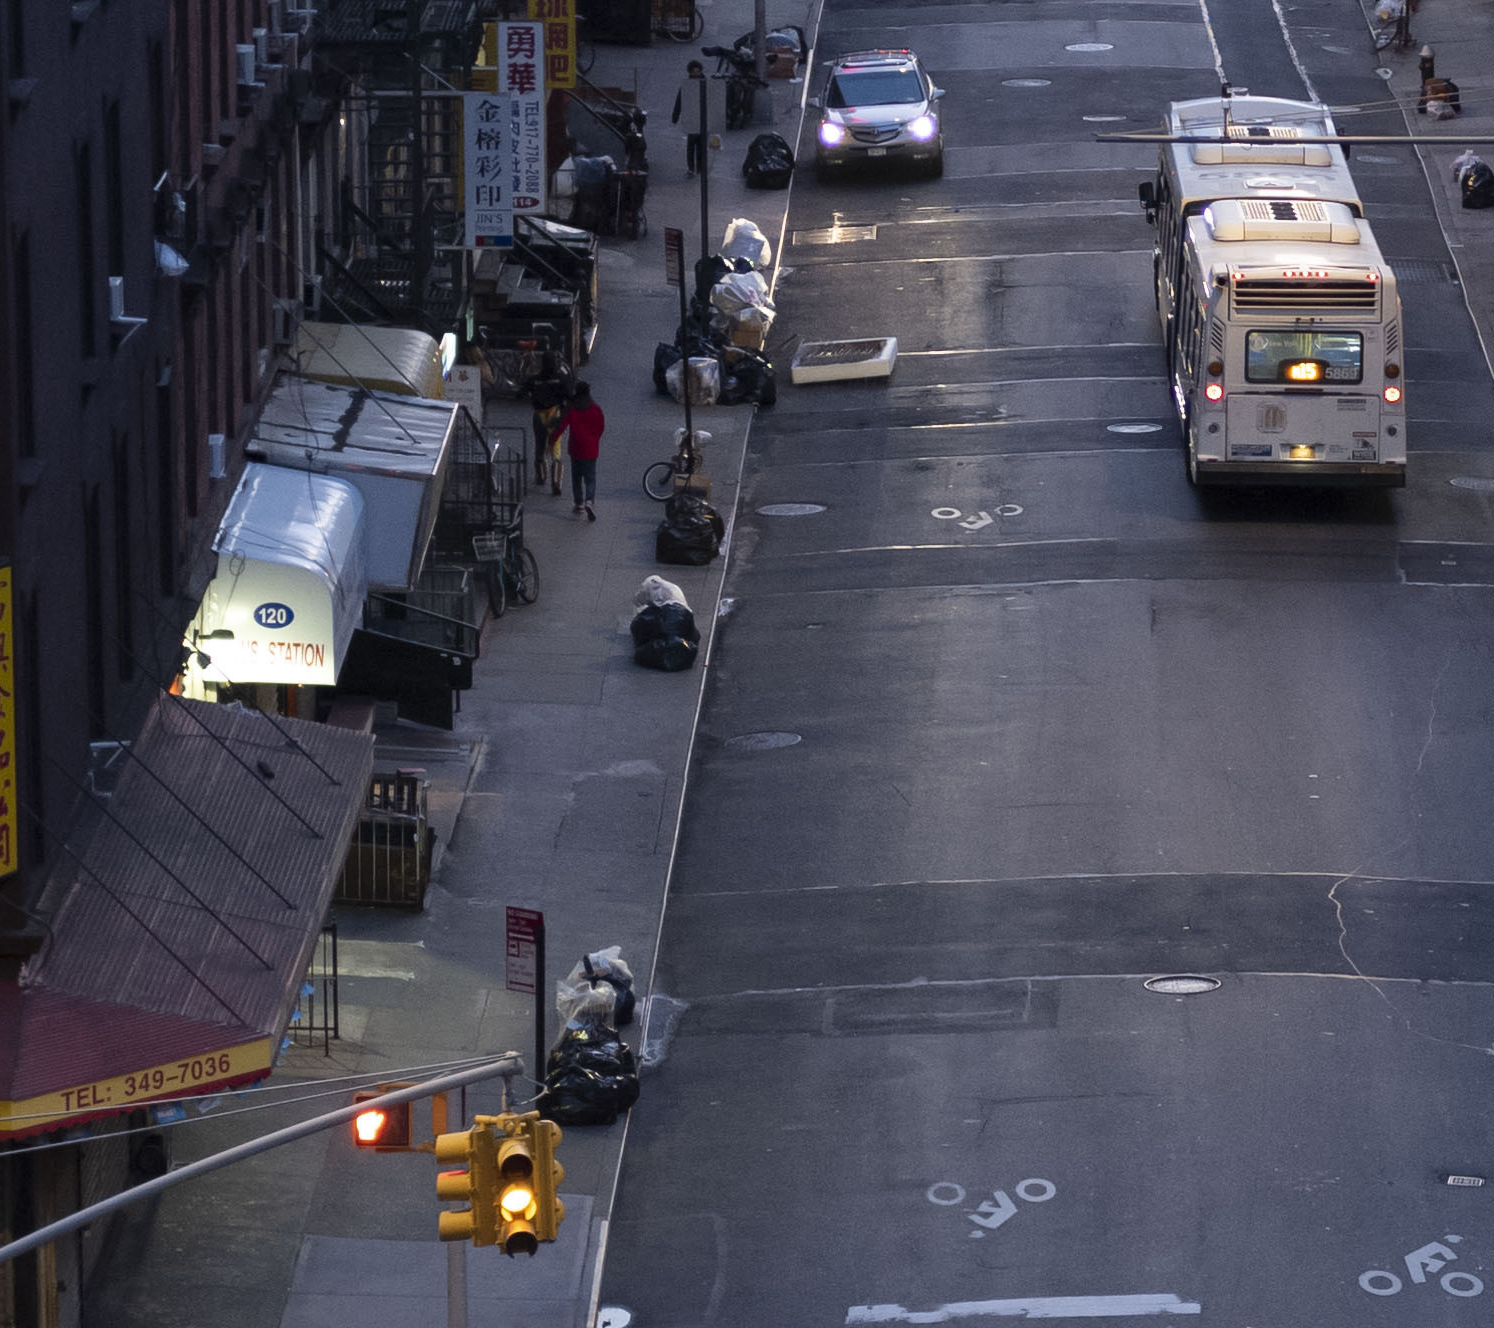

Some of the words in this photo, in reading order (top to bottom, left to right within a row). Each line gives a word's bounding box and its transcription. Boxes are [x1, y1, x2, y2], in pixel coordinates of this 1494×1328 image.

[476, 213, 503, 223] JIN'S
[259, 608, 287, 624] 120
[269, 642, 324, 666] STATION
[60, 1085, 112, 1111] TEL:
[124, 1054, 230, 1097] 349-7036
